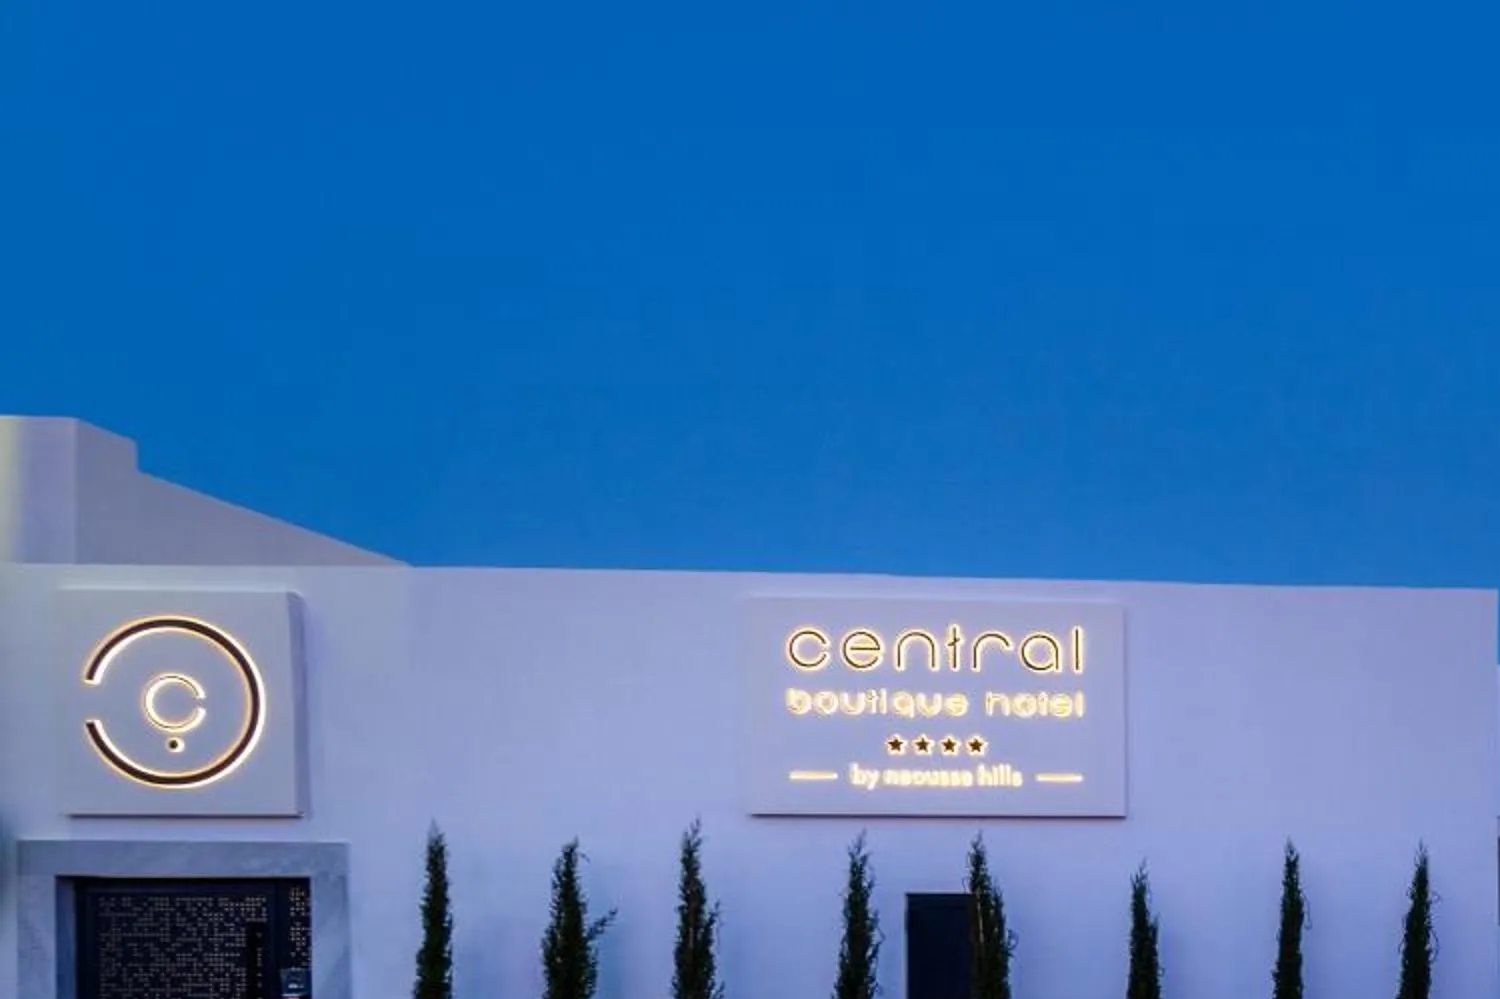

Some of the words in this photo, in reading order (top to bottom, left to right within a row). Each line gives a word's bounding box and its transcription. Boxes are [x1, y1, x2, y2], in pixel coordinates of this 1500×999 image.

[787, 625, 1085, 673] central
[786, 688, 970, 717] boutique
[985, 691, 1086, 718] hotel
[851, 763, 880, 789] by
[977, 763, 1023, 787] hills
